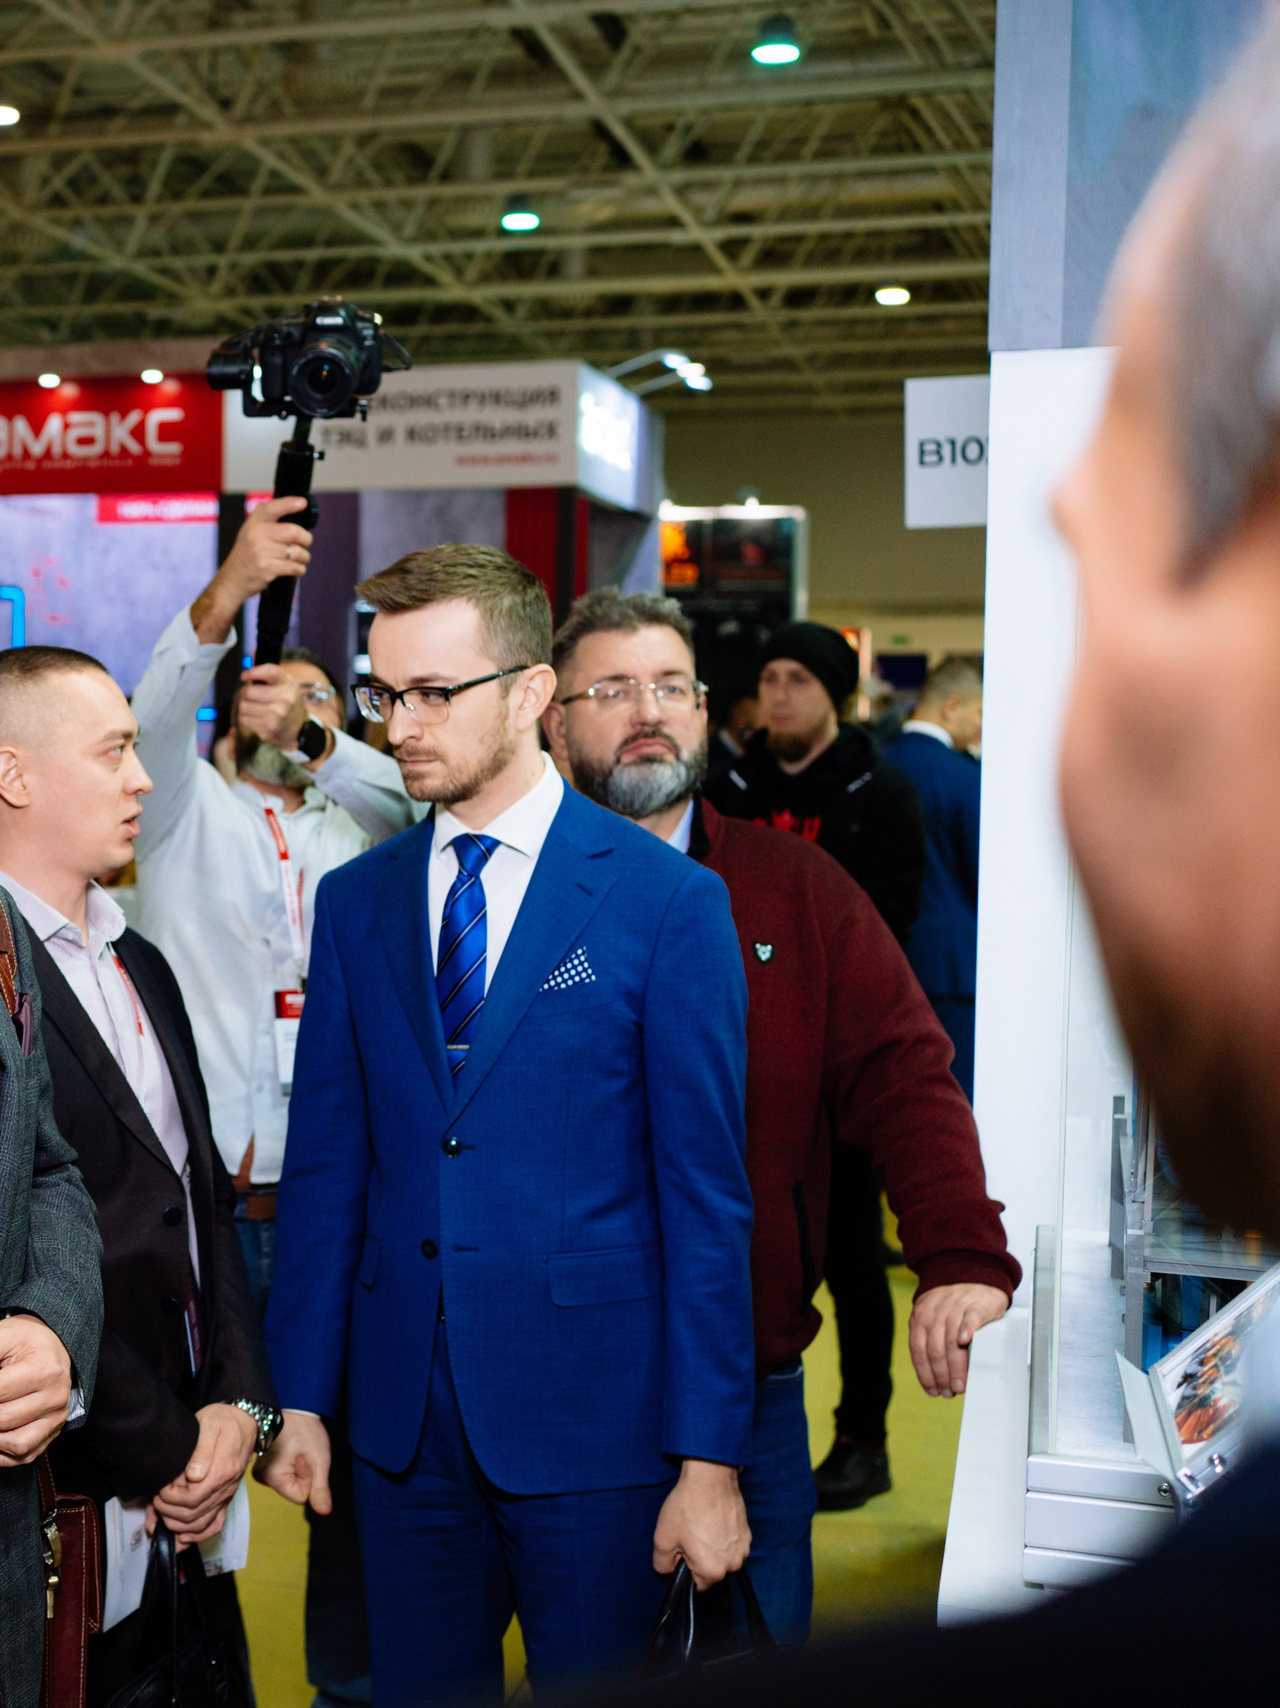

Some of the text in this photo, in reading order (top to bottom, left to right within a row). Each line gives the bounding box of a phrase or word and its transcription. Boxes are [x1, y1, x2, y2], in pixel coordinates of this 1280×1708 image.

[368, 385, 561, 413] ЕКОНСТРУКЦИЯ
[376, 424, 396, 445] И
[404, 417, 560, 446] КОТЕЛЬНЫХ
[918, 437, 988, 467] B10
